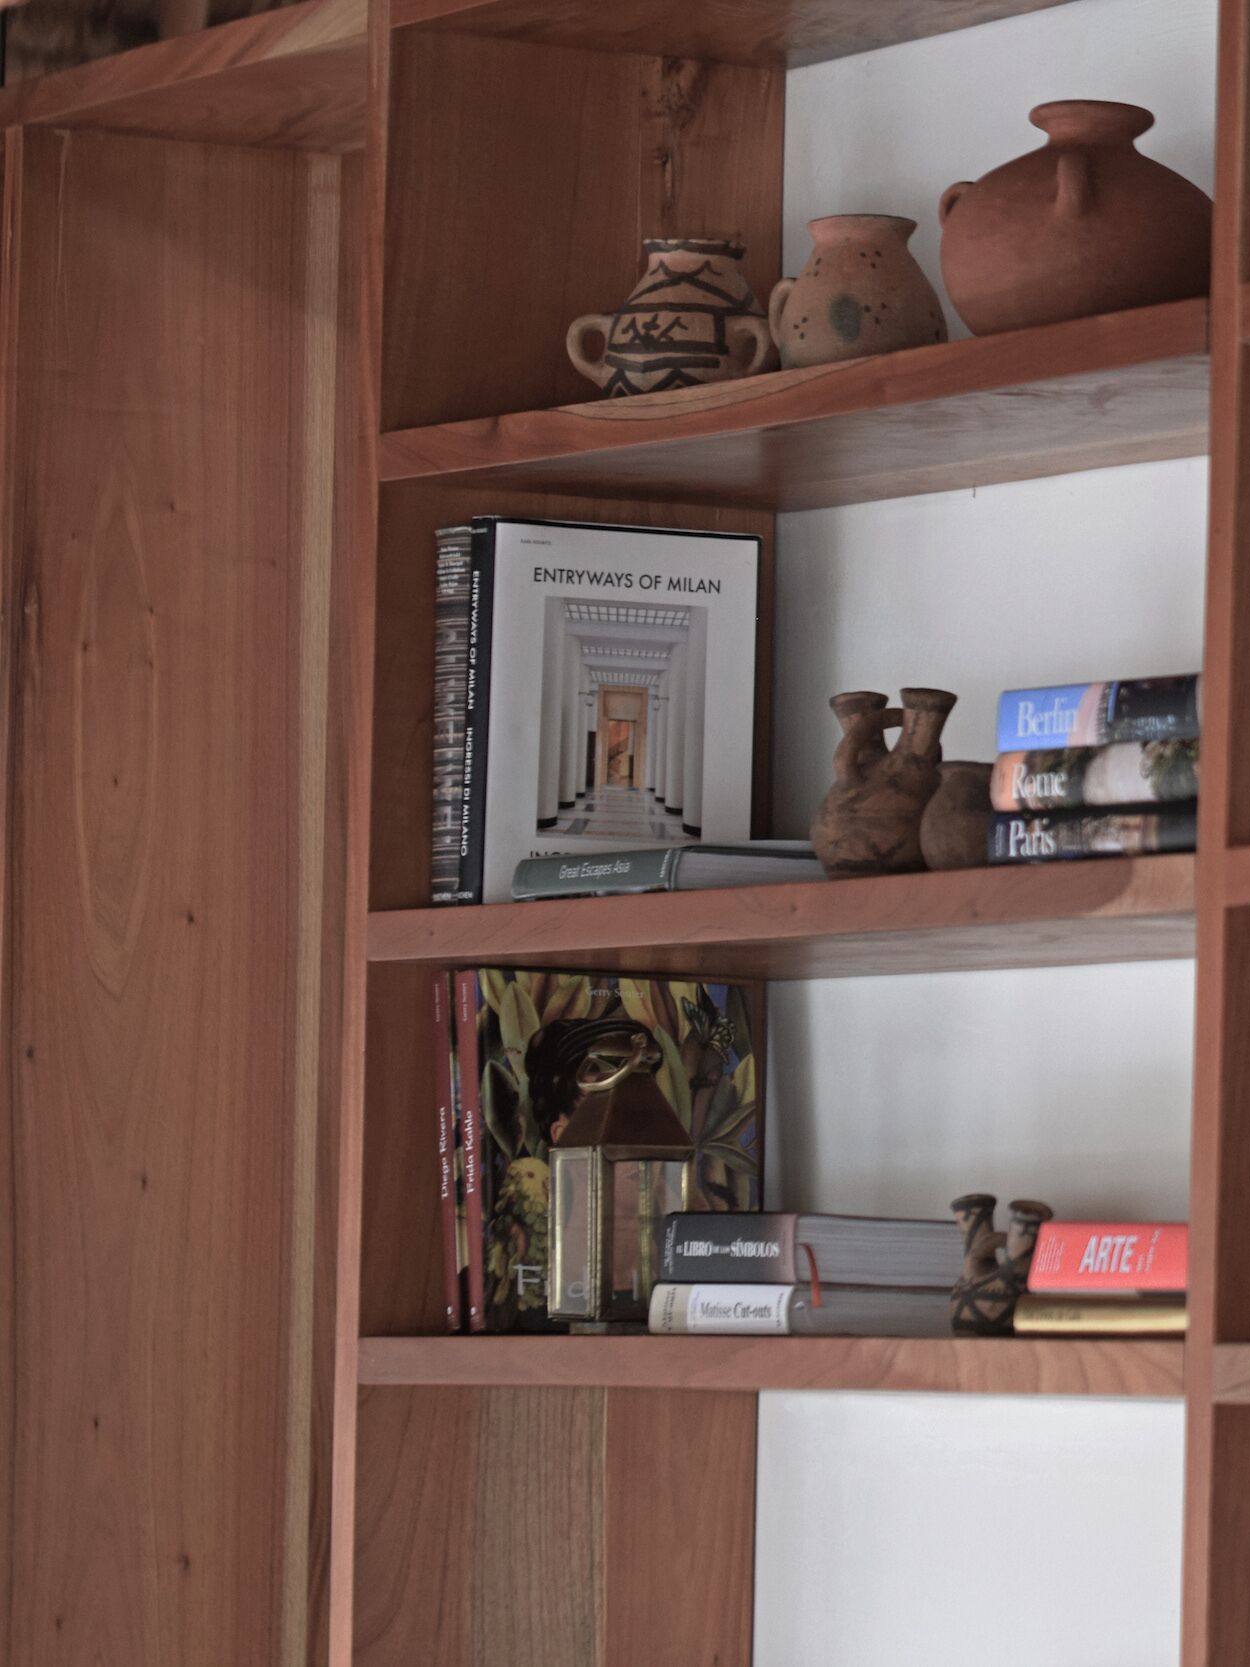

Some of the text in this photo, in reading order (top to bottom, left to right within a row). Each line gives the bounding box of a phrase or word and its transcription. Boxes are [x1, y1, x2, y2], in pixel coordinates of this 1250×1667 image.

[532, 566, 721, 594] ENTRYWAYS OF MILAN
[460, 570, 480, 857] ENTRYWAYS OF MILAN INGRESSI DI MILANO
[1016, 697, 1079, 737] Berlin
[1011, 763, 1069, 800] Rome
[1008, 818, 1057, 857] Paris
[558, 860, 630, 879] Great Escapes Asia
[439, 1106, 449, 1199] Diego Rivera
[464, 1110, 475, 1194] Frida Kahlo
[683, 1240, 713, 1256] LIBRO
[730, 1237, 780, 1258] SÍMBOLOS
[1078, 1235, 1138, 1273] ARTE
[700, 1302, 732, 1318] Matisse
[733, 1302, 772, 1319] Cut-outs
